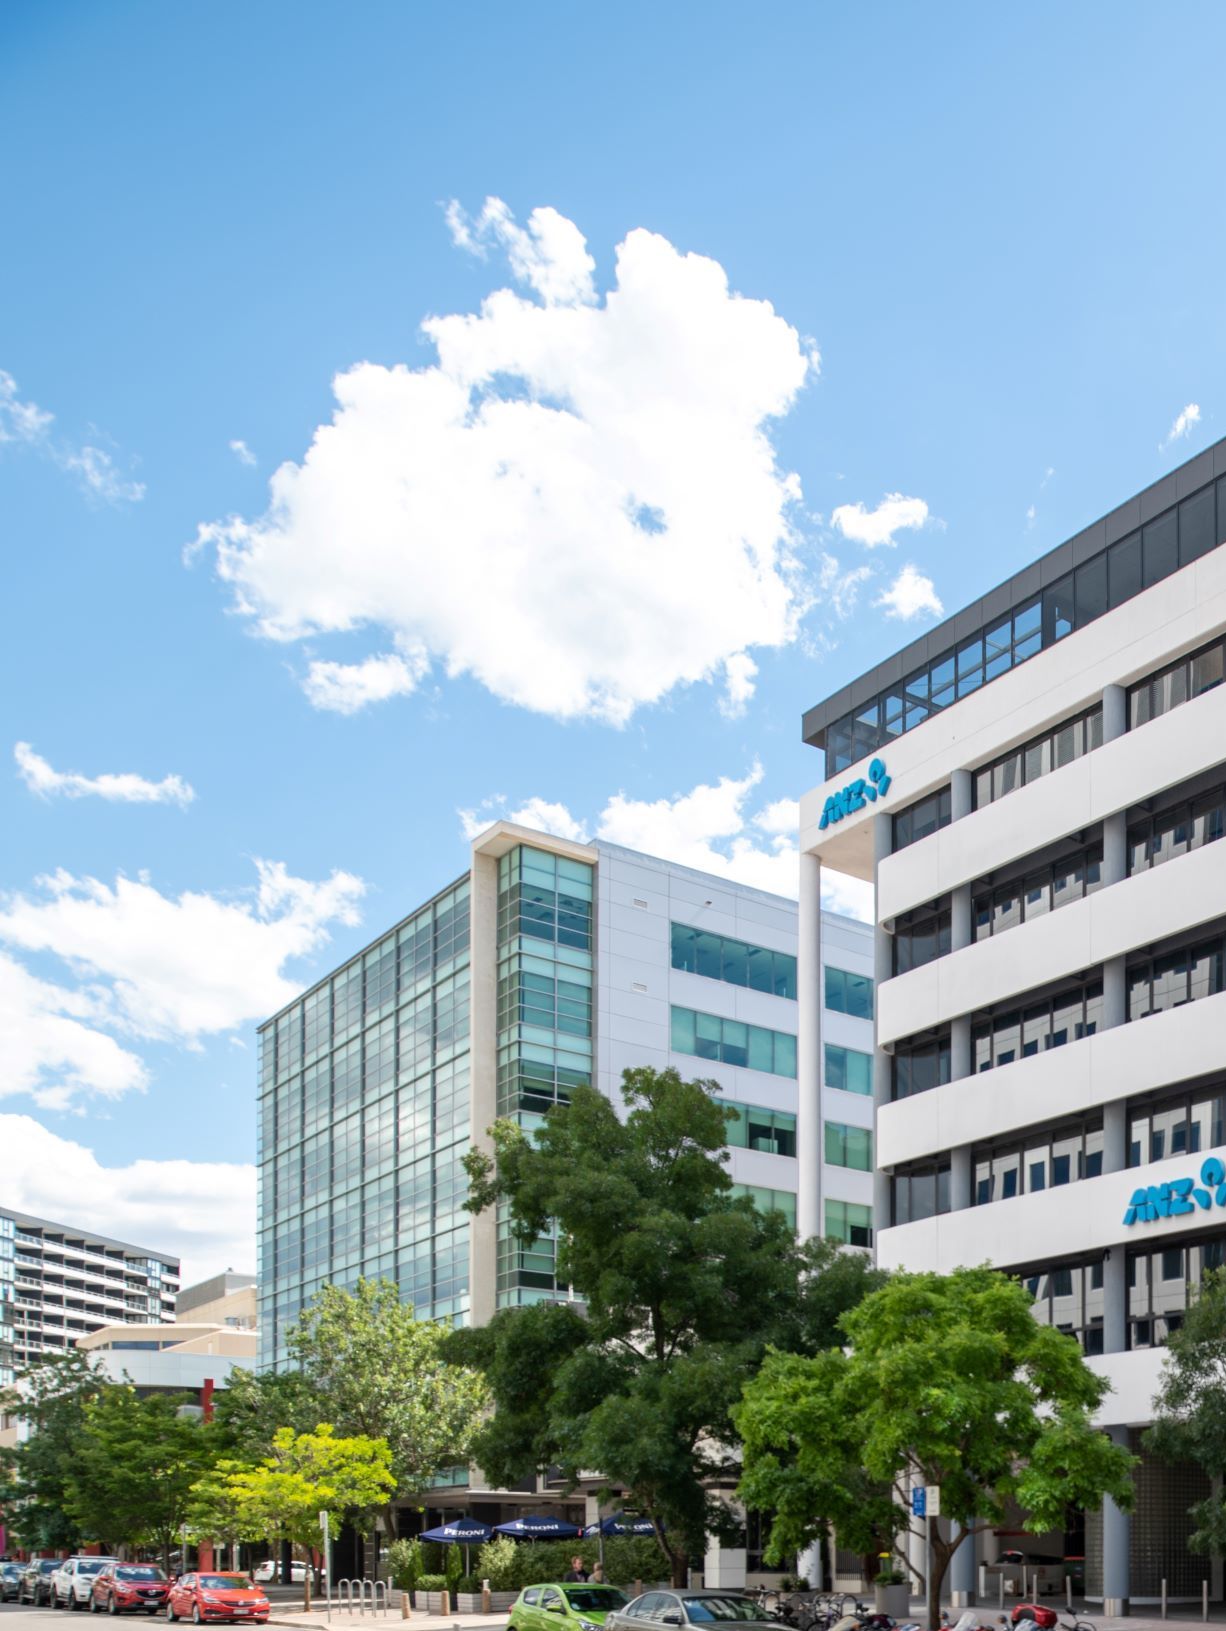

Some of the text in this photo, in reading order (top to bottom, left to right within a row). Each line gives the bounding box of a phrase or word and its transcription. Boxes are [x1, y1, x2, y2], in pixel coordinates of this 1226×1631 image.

[819, 778, 867, 830] ANZ
[1122, 1178, 1195, 1226] ANZ
[515, 1522, 559, 1531] PERONI
[614, 1522, 653, 1531] PEONI
[443, 1527, 485, 1537] PERONI
